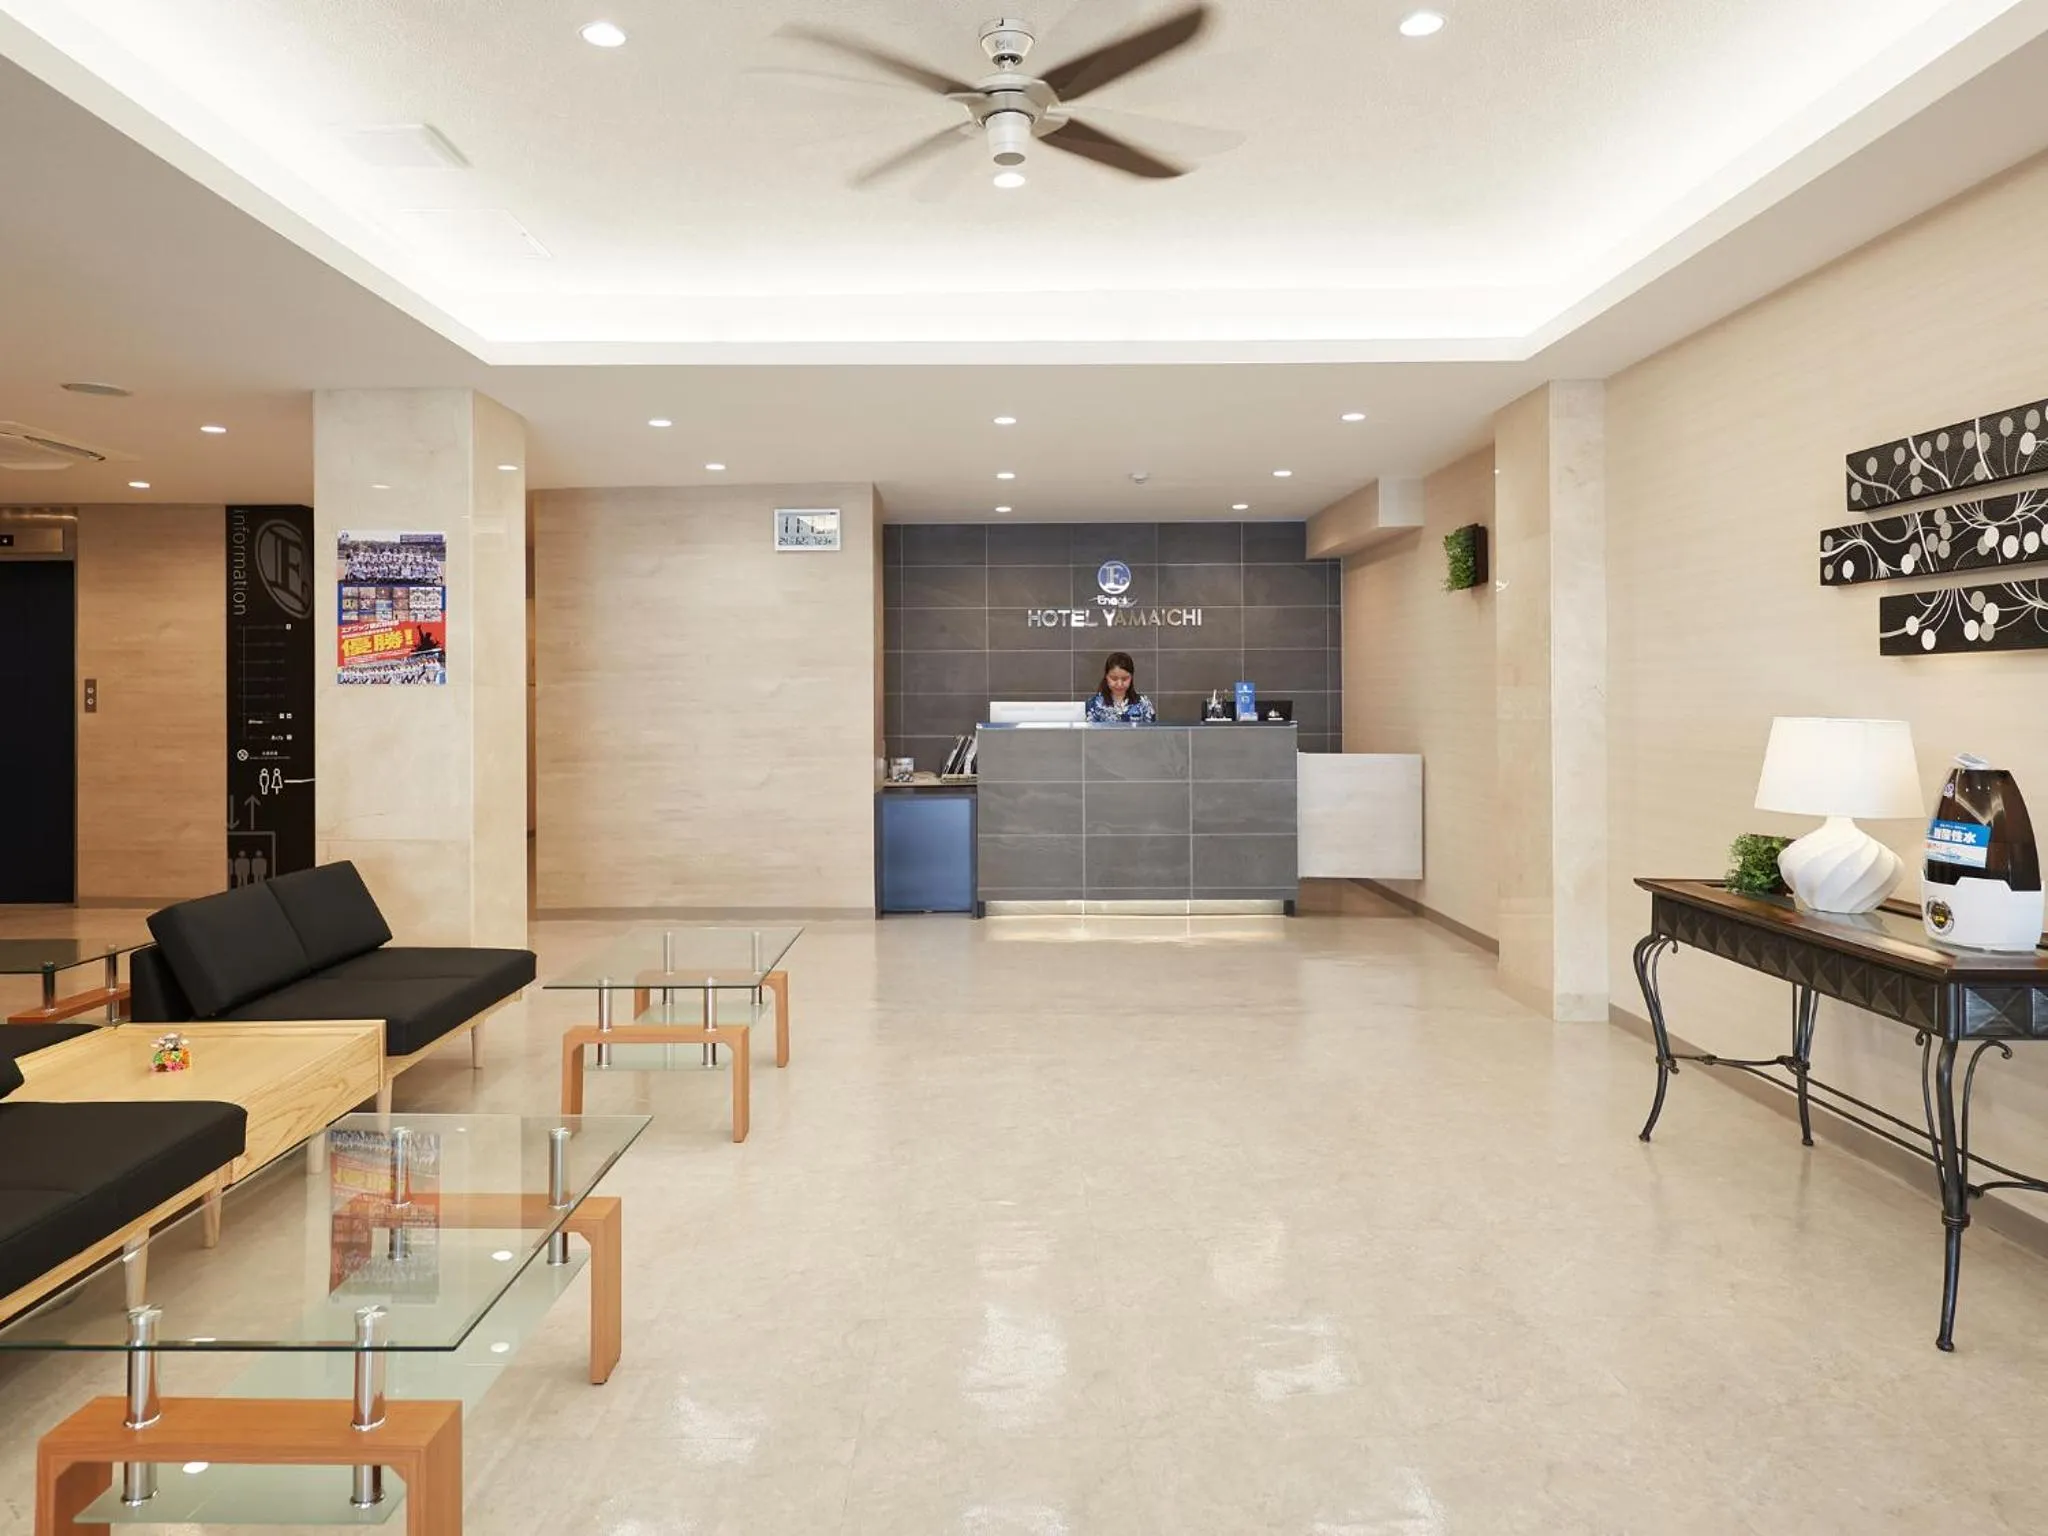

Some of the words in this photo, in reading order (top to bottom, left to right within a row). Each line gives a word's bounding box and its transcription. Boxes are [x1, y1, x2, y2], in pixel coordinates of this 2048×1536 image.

[232, 509, 249, 615] information
[1027, 609, 1098, 627] HOTEL
[1102, 609, 1202, 627] YAMAICHI
